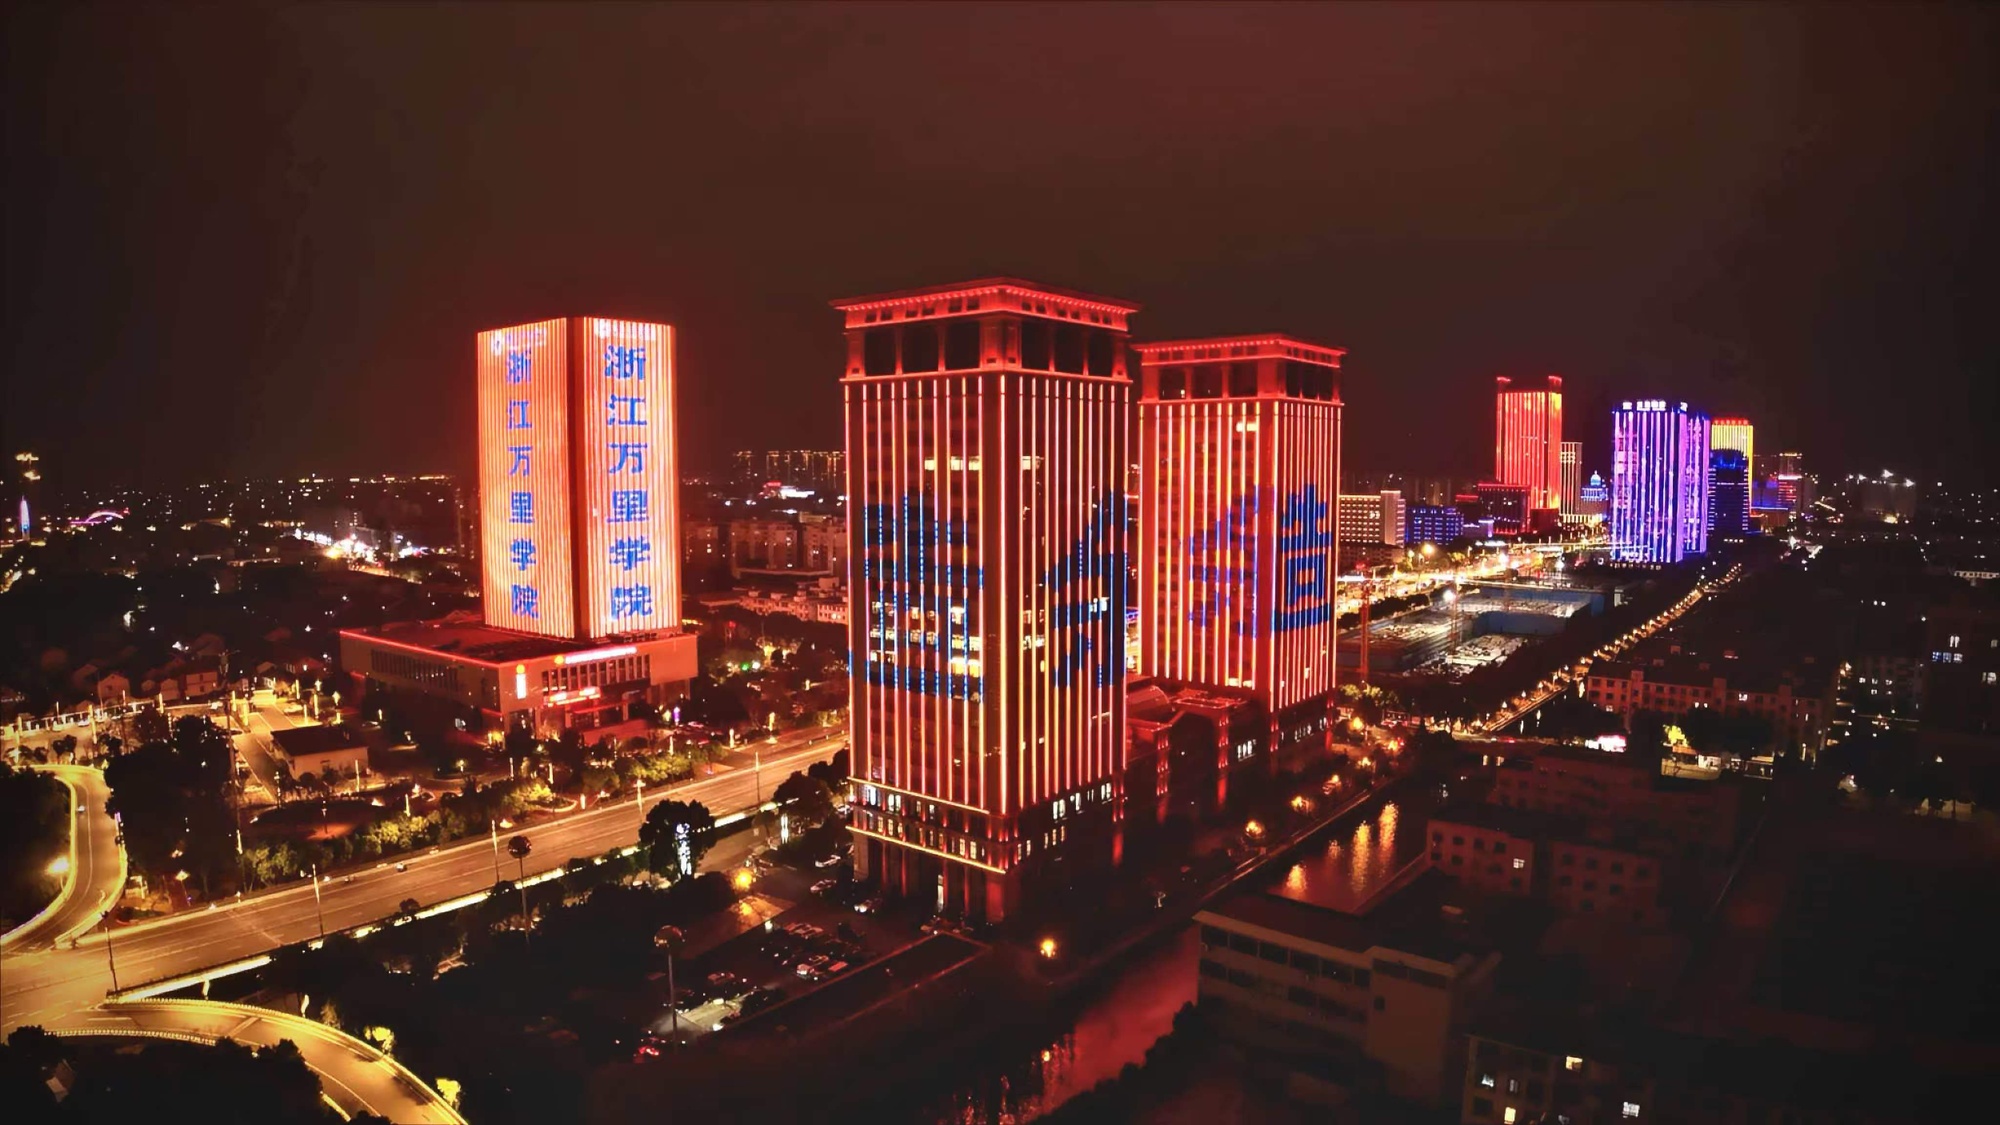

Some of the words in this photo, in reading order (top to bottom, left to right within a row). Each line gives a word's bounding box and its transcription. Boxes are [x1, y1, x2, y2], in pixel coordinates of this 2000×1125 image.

[506, 350, 539, 619] 浙江万里学院
[604, 345, 652, 620] 浙江万里学院
